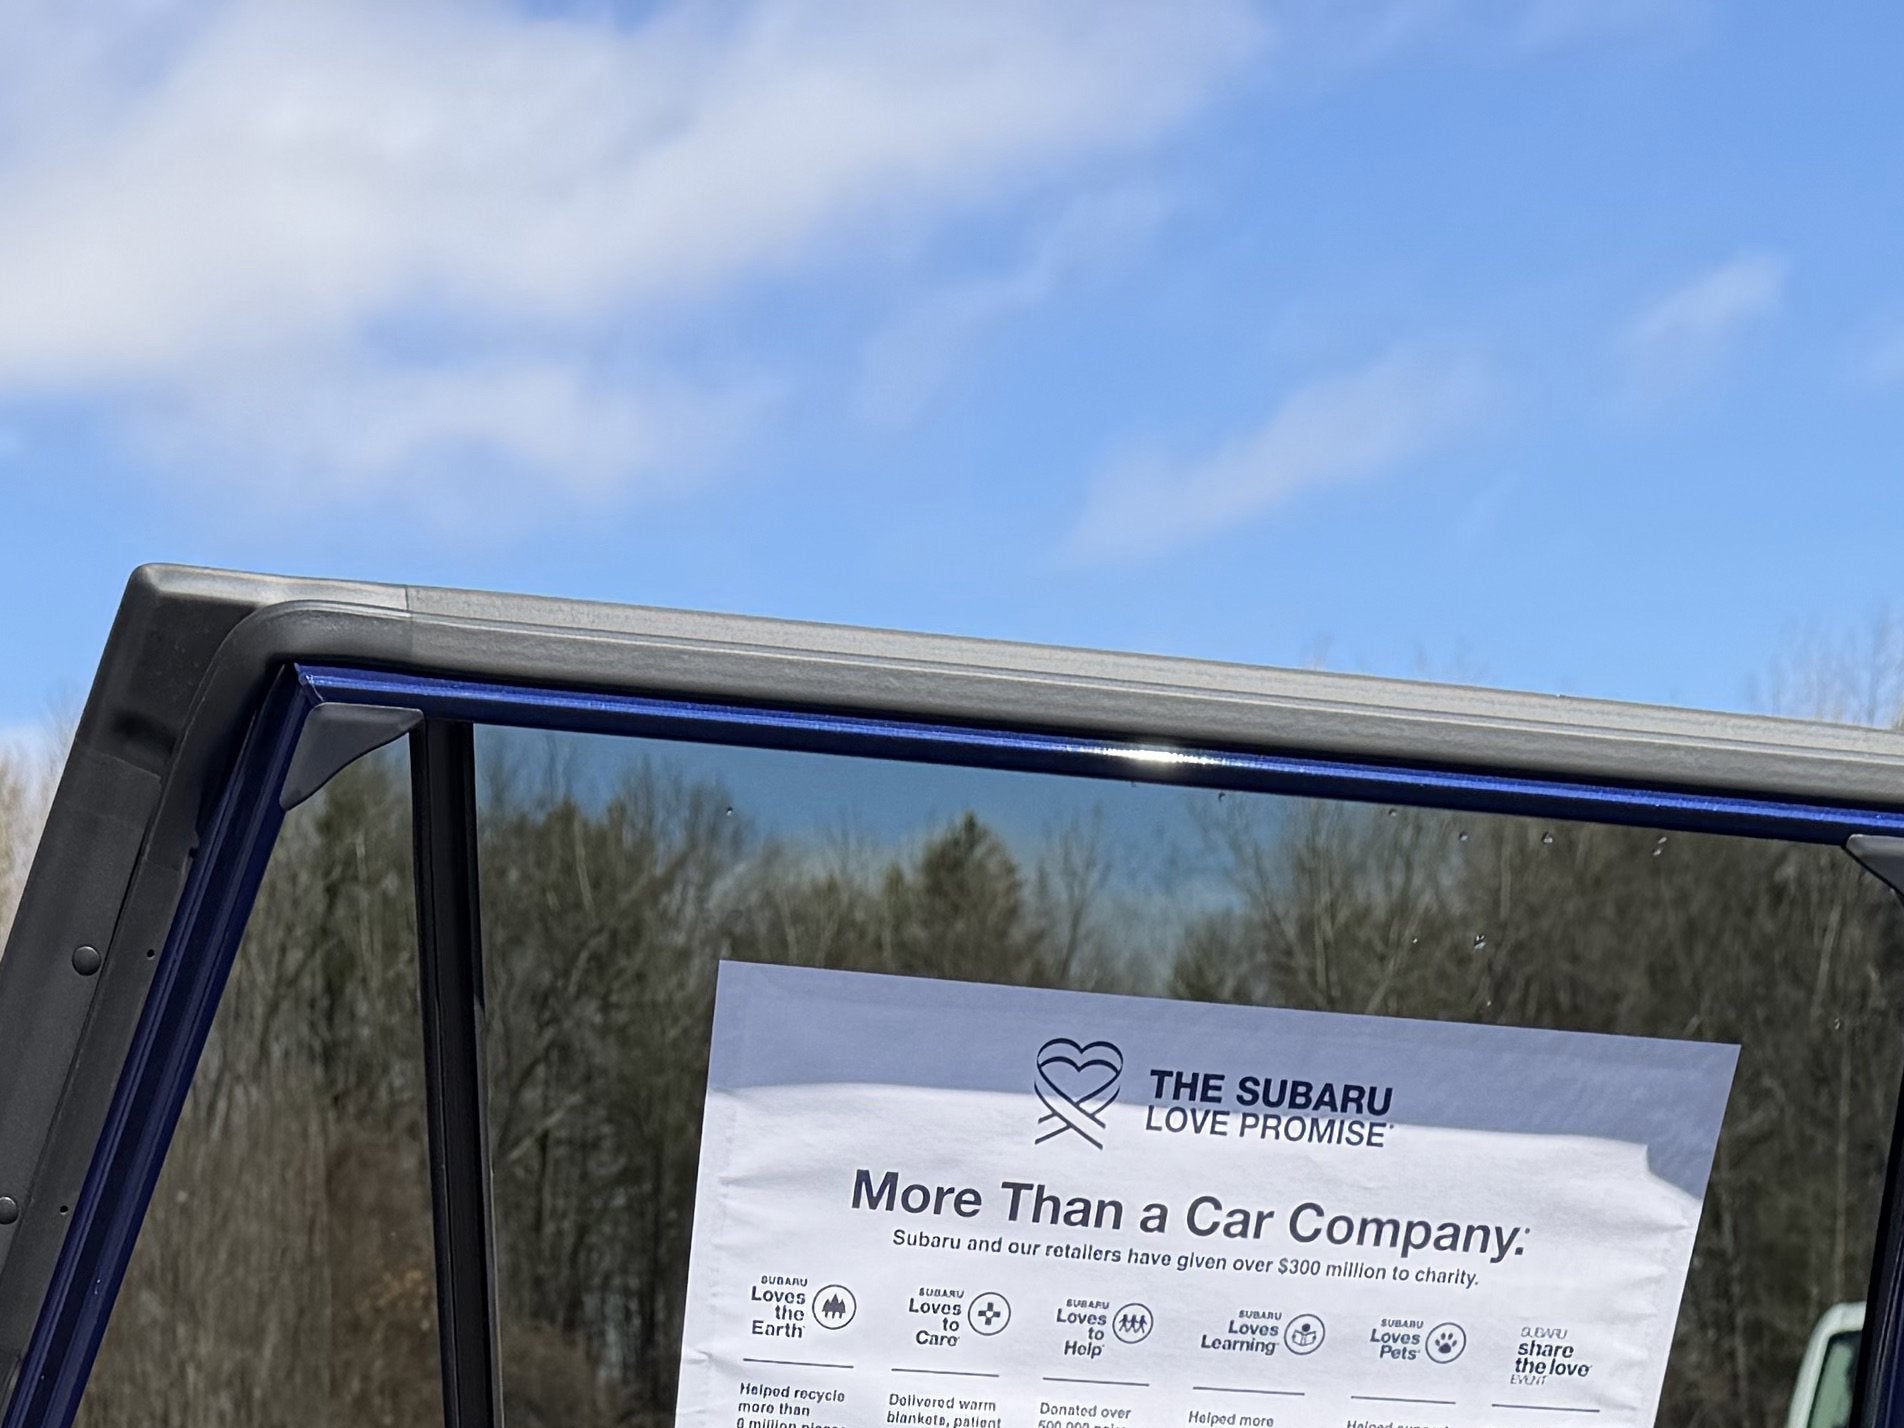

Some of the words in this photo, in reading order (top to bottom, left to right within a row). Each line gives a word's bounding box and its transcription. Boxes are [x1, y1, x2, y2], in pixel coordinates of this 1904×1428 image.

[1149, 1068, 1226, 1107] THE
[1235, 1075, 1394, 1117] SUBARU
[1146, 1105, 1229, 1137] LOVE
[1239, 1111, 1386, 1148] PROMISE
[851, 1168, 983, 1219] More
[1000, 1180, 1124, 1231] Than
[1139, 1202, 1169, 1234] a
[1186, 1195, 1276, 1240] Car
[892, 1228, 962, 1250] Subaru
[966, 1236, 1003, 1254] and
[1007, 1241, 1042, 1256] our
[1044, 1242, 1122, 1263] retailers
[1127, 1247, 1172, 1267] have
[1176, 1251, 1227, 1272] given
[1232, 1258, 1274, 1273] over
[1277, 1256, 1322, 1277] $300
[1325, 1260, 1387, 1280] million
[1392, 1265, 1410, 1282] to
[1414, 1266, 1479, 1290] charity.
[750, 1285, 806, 1306] Loves
[774, 1303, 805, 1322] the
[908, 1297, 963, 1317] Loves
[1056, 1307, 1108, 1327] Loves
[751, 1319, 806, 1339] Earth
[942, 1316, 960, 1333] to
[1087, 1326, 1105, 1342] to
[1227, 1319, 1280, 1337] Loves
[915, 1329, 961, 1348] Care
[1200, 1334, 1280, 1357] Learning
[1369, 1327, 1421, 1346] Loves
[1063, 1339, 1103, 1360] Help
[1379, 1343, 1421, 1361] Pets
[1517, 1339, 1575, 1363] share
[1514, 1357, 1546, 1375] the
[1549, 1357, 1590, 1378] love
[739, 1381, 791, 1400] Helped
[793, 1389, 846, 1405] recycle
[888, 1392, 955, 1410] Delivered
[958, 1400, 997, 1412] warm
[737, 1402, 775, 1415] more
[779, 1402, 811, 1417] than
[886, 1410, 950, 1428] blankets,
[1039, 1401, 1098, 1418] Donated
[1100, 1408, 1132, 1420] over
[1188, 1410, 1237, 1428] Helped
[1239, 1416, 1275, 1428] more
